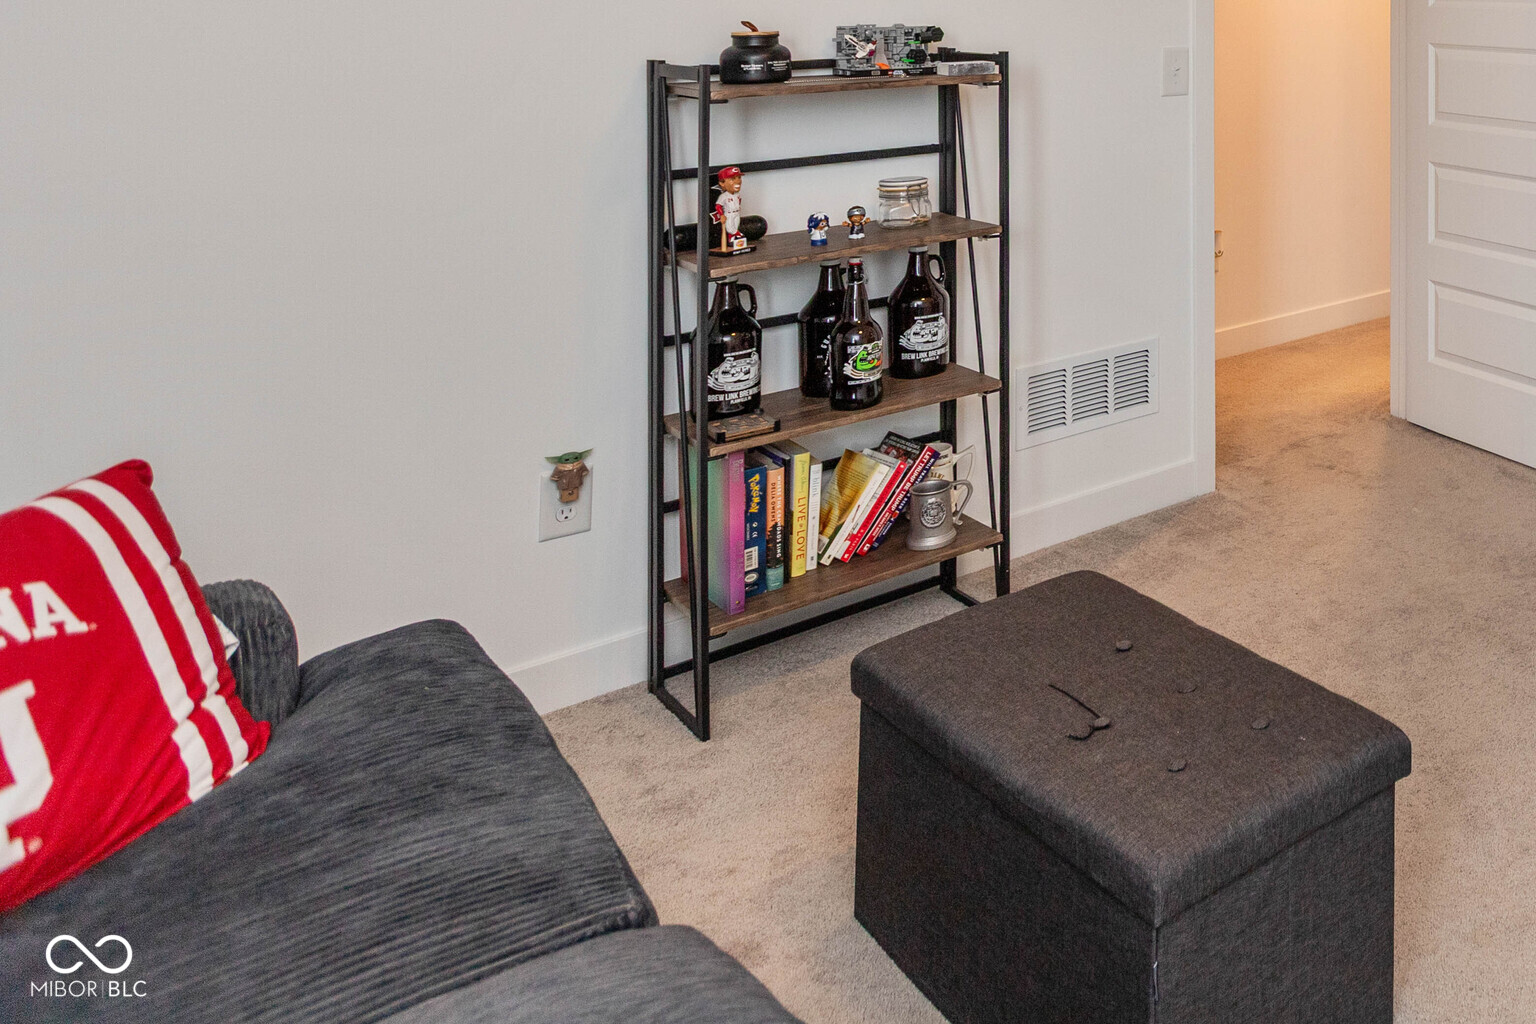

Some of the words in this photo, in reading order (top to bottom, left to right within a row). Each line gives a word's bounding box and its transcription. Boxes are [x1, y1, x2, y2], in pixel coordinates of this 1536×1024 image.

[901, 352, 915, 360] BREW
[916, 351, 928, 359] LINK
[725, 391, 739, 401] LINK
[921, 451, 932, 464] LET
[925, 457, 935, 470] WILL
[909, 462, 925, 483] TRUMP
[811, 477, 820, 498] blink
[903, 481, 912, 491] BE
[797, 496, 806, 522] LIVE
[890, 490, 907, 512] TRUMP
[796, 530, 806, 561] LOVE
